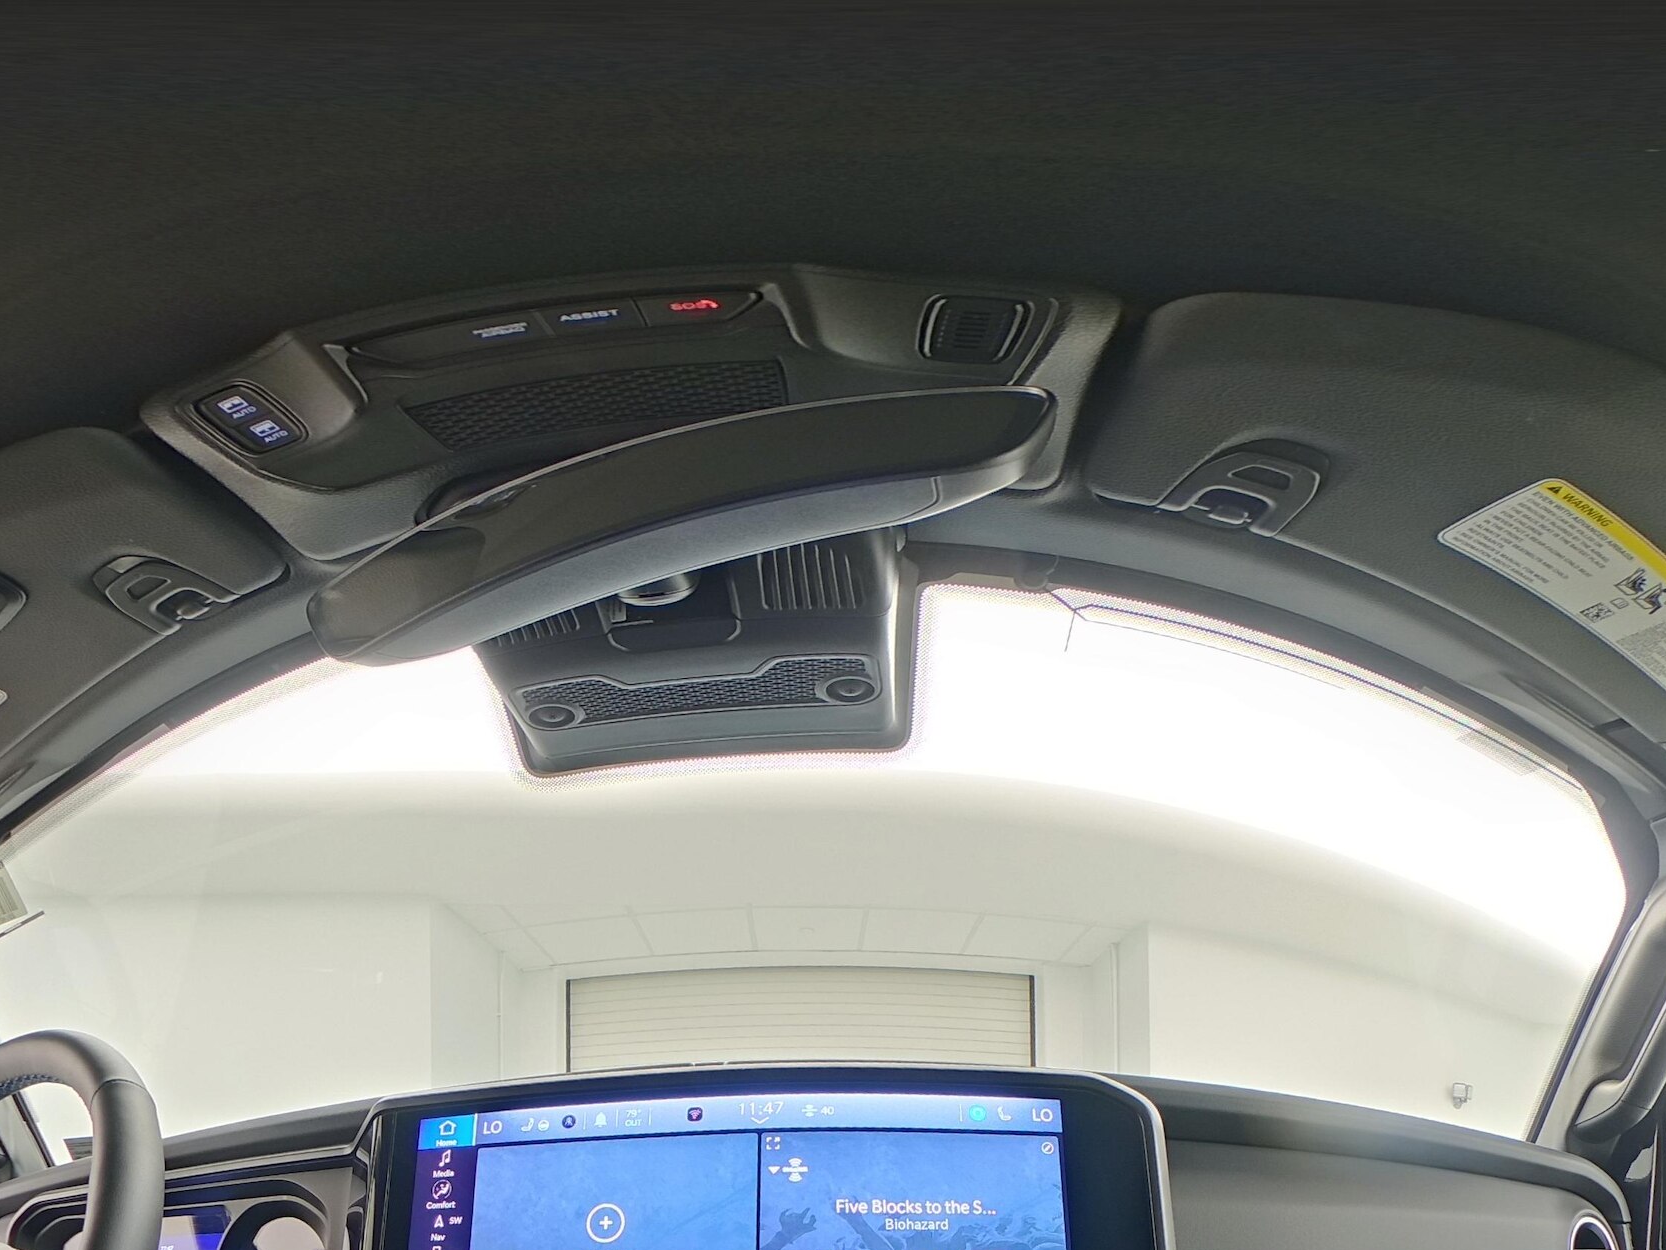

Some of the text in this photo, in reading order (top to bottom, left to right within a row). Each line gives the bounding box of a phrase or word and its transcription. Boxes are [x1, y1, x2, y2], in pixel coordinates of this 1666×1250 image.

[670, 301, 706, 310] SOS
[560, 308, 619, 322] ASSIST
[232, 406, 257, 419] AUTO
[264, 430, 289, 443] AUTO
[1562, 493, 1614, 528] WARNING
[739, 1101, 785, 1116] 11:47
[820, 1106, 835, 1116] 40
[1032, 1108, 1053, 1123] LO
[483, 1120, 503, 1135] LO
[624, 1118, 642, 1127] OUT
[436, 1139, 458, 1147] Home
[433, 1169, 454, 1178] Media
[426, 1200, 456, 1209] Comfort
[835, 1199, 996, 1215] Five Blocks to the S...
[448, 1216, 463, 1225] SW
[885, 1218, 949, 1231] Biohazard
[430, 1233, 446, 1241] Nav
